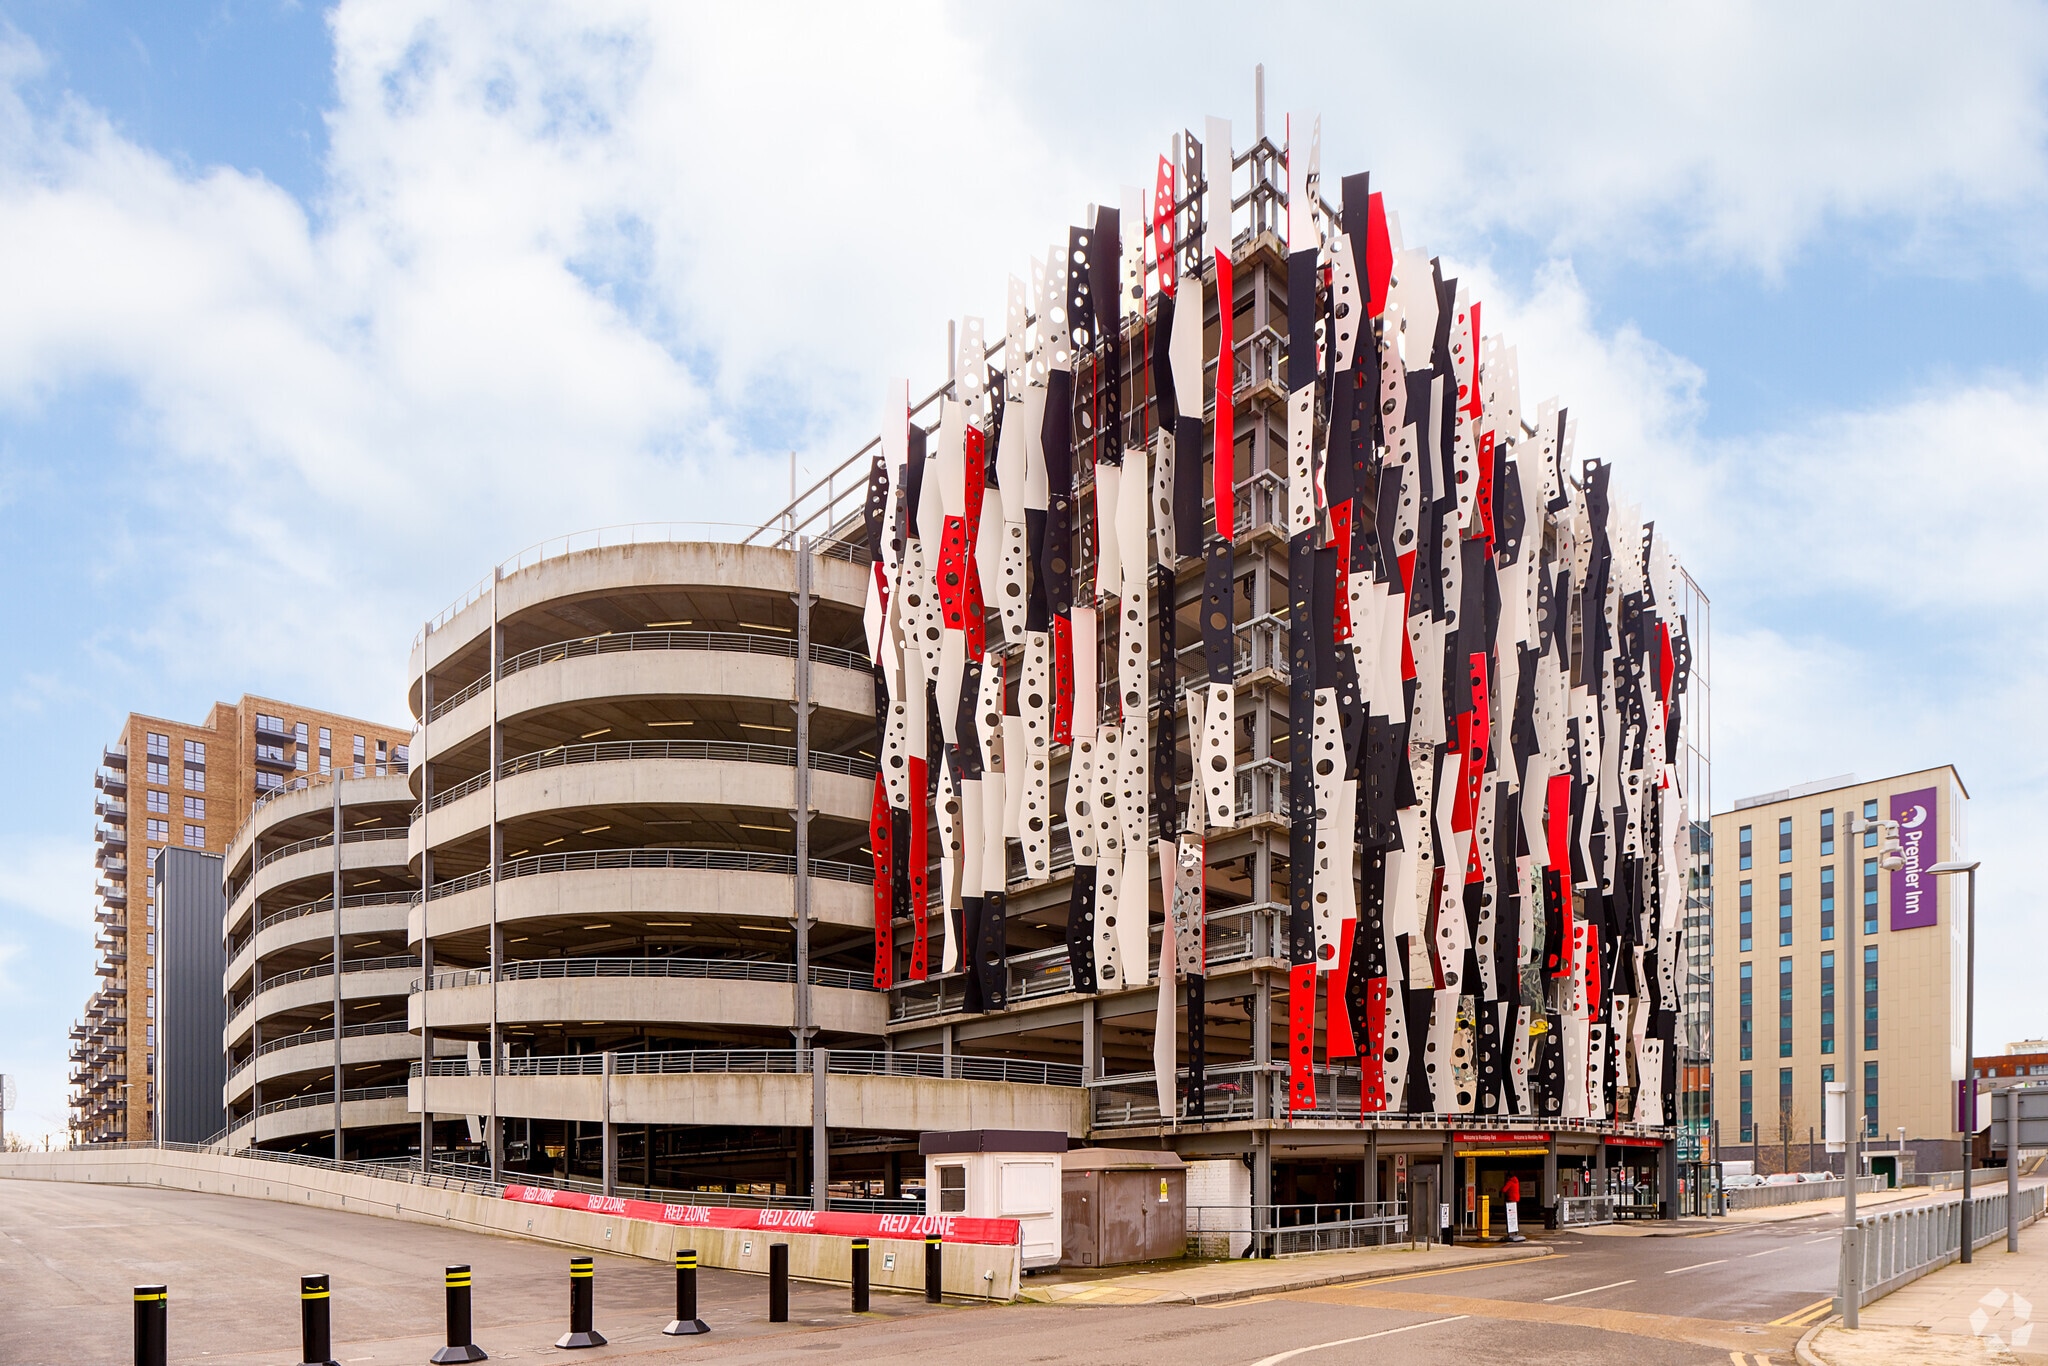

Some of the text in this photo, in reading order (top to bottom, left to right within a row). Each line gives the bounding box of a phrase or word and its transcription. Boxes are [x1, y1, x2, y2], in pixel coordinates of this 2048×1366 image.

[1905, 830, 1923, 914] Premier Inn
[523, 1187, 556, 1203] RED ZONE
[588, 1195, 626, 1212] RED ZONE
[664, 1204, 711, 1222] RED ZONE
[759, 1209, 816, 1227] RED ZONE
[879, 1214, 955, 1235] RED ZONE
